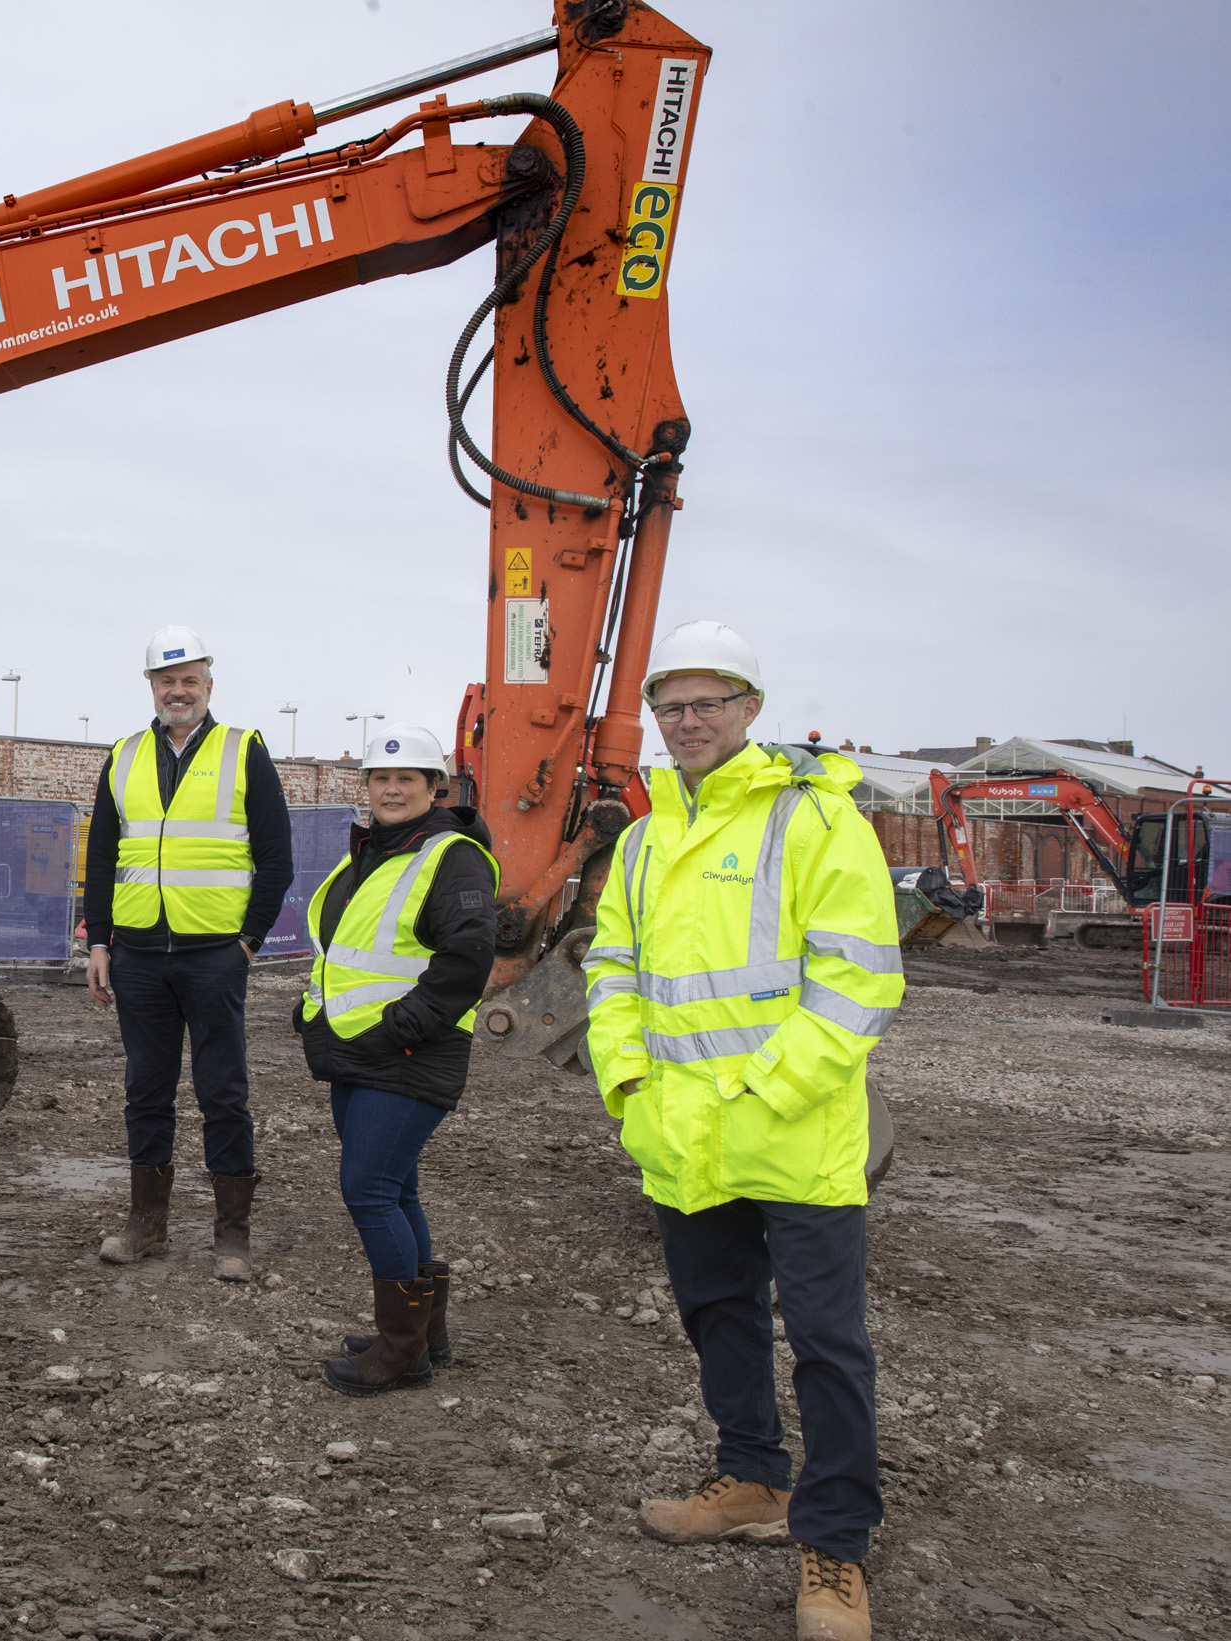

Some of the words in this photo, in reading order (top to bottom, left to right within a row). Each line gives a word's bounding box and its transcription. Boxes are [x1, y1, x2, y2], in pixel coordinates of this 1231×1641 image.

[652, 66, 688, 175] HITACHI
[52, 198, 334, 310] HITACHI
[534, 630, 542, 663] TEFRA
[702, 871, 754, 886] ClwydAlyn
[775, 989, 789, 997] RFX
